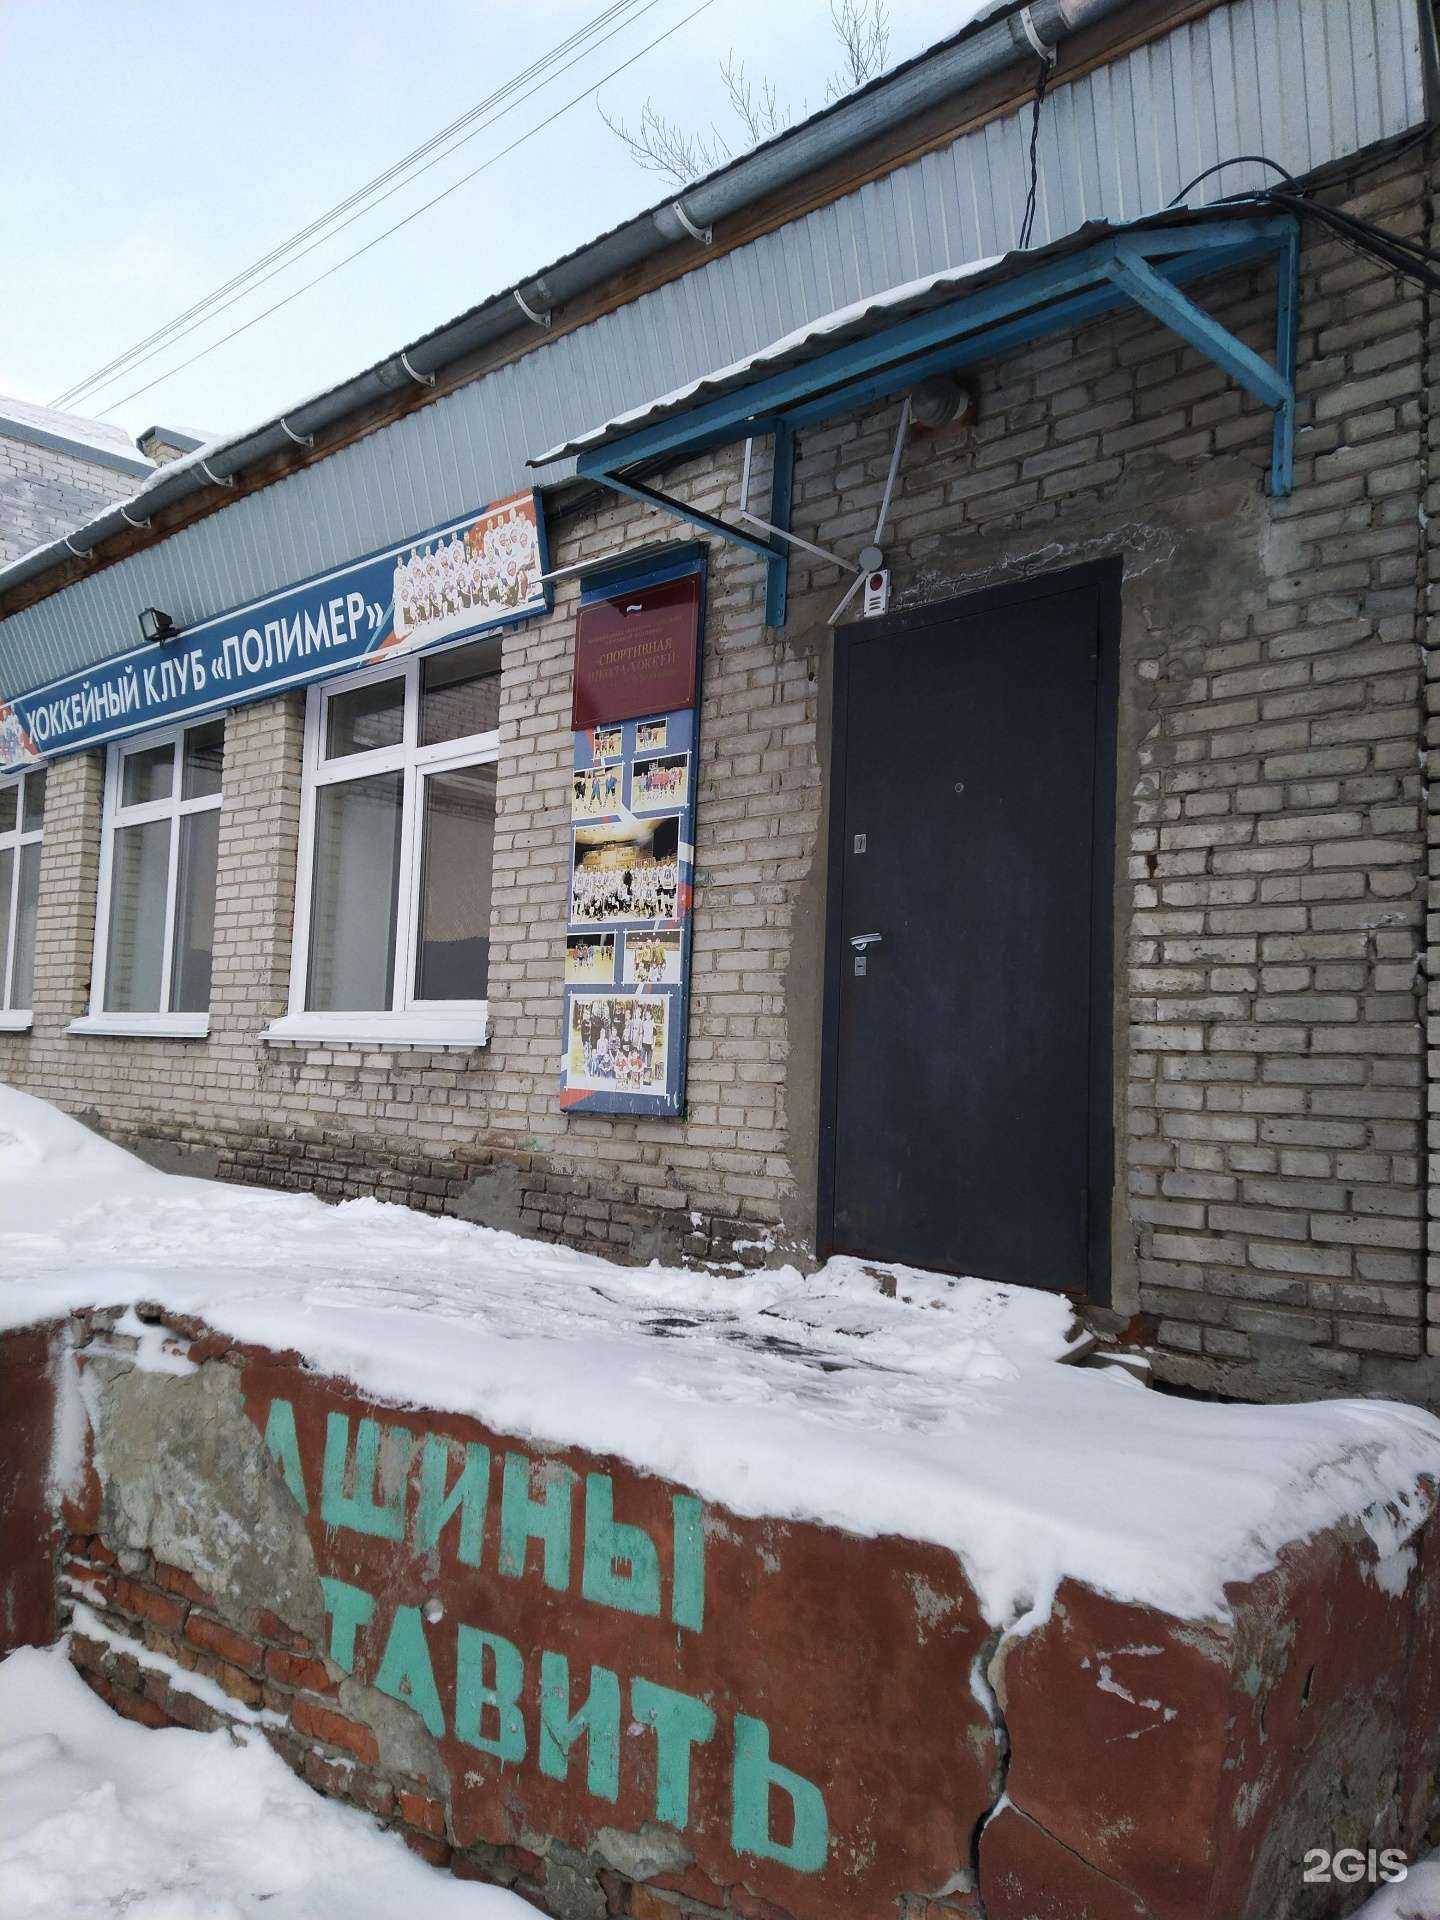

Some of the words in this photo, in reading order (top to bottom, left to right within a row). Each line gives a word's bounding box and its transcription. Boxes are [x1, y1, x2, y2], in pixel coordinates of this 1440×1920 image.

[26, 664, 141, 743] ХОККЕЙНЫЙ
[143, 648, 207, 706] КЛУБ
[211, 591, 384, 681] «ПОЛИМЕР»
